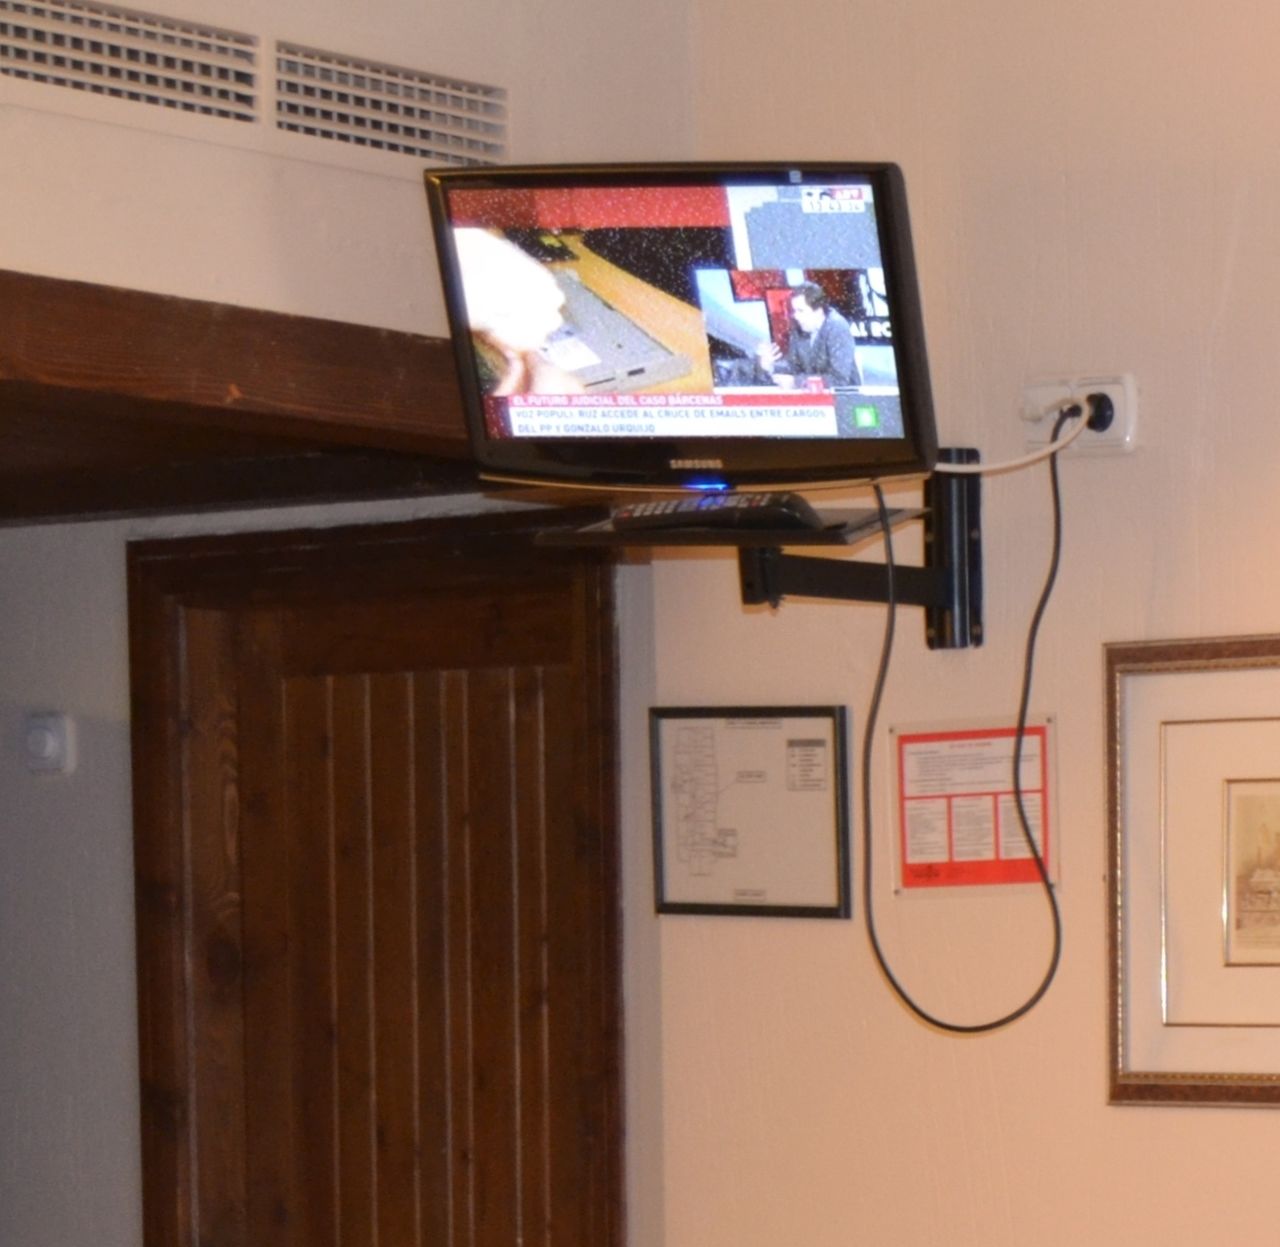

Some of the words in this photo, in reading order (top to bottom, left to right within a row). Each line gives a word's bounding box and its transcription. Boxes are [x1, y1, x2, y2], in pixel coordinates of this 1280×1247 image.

[513, 395, 527, 405] EL
[527, 395, 568, 405] FUTURO
[571, 395, 616, 405] JUDICIAL
[617, 395, 637, 405] DEL
[639, 395, 666, 405] CASO
[577, 410, 598, 419] RUZ
[601, 410, 638, 419] ACCEDE
[642, 410, 654, 419] AL
[657, 410, 689, 419] CRUCE
[693, 410, 706, 419] DE
[709, 410, 746, 419] EMAILS
[750, 410, 783, 419] ENTRE
[785, 410, 826, 419] CARGOS
[518, 424, 536, 433] DEL
[539, 424, 552, 433] PP
[563, 424, 610, 433] GONZALO
[669, 458, 723, 469] SAMSUNG
